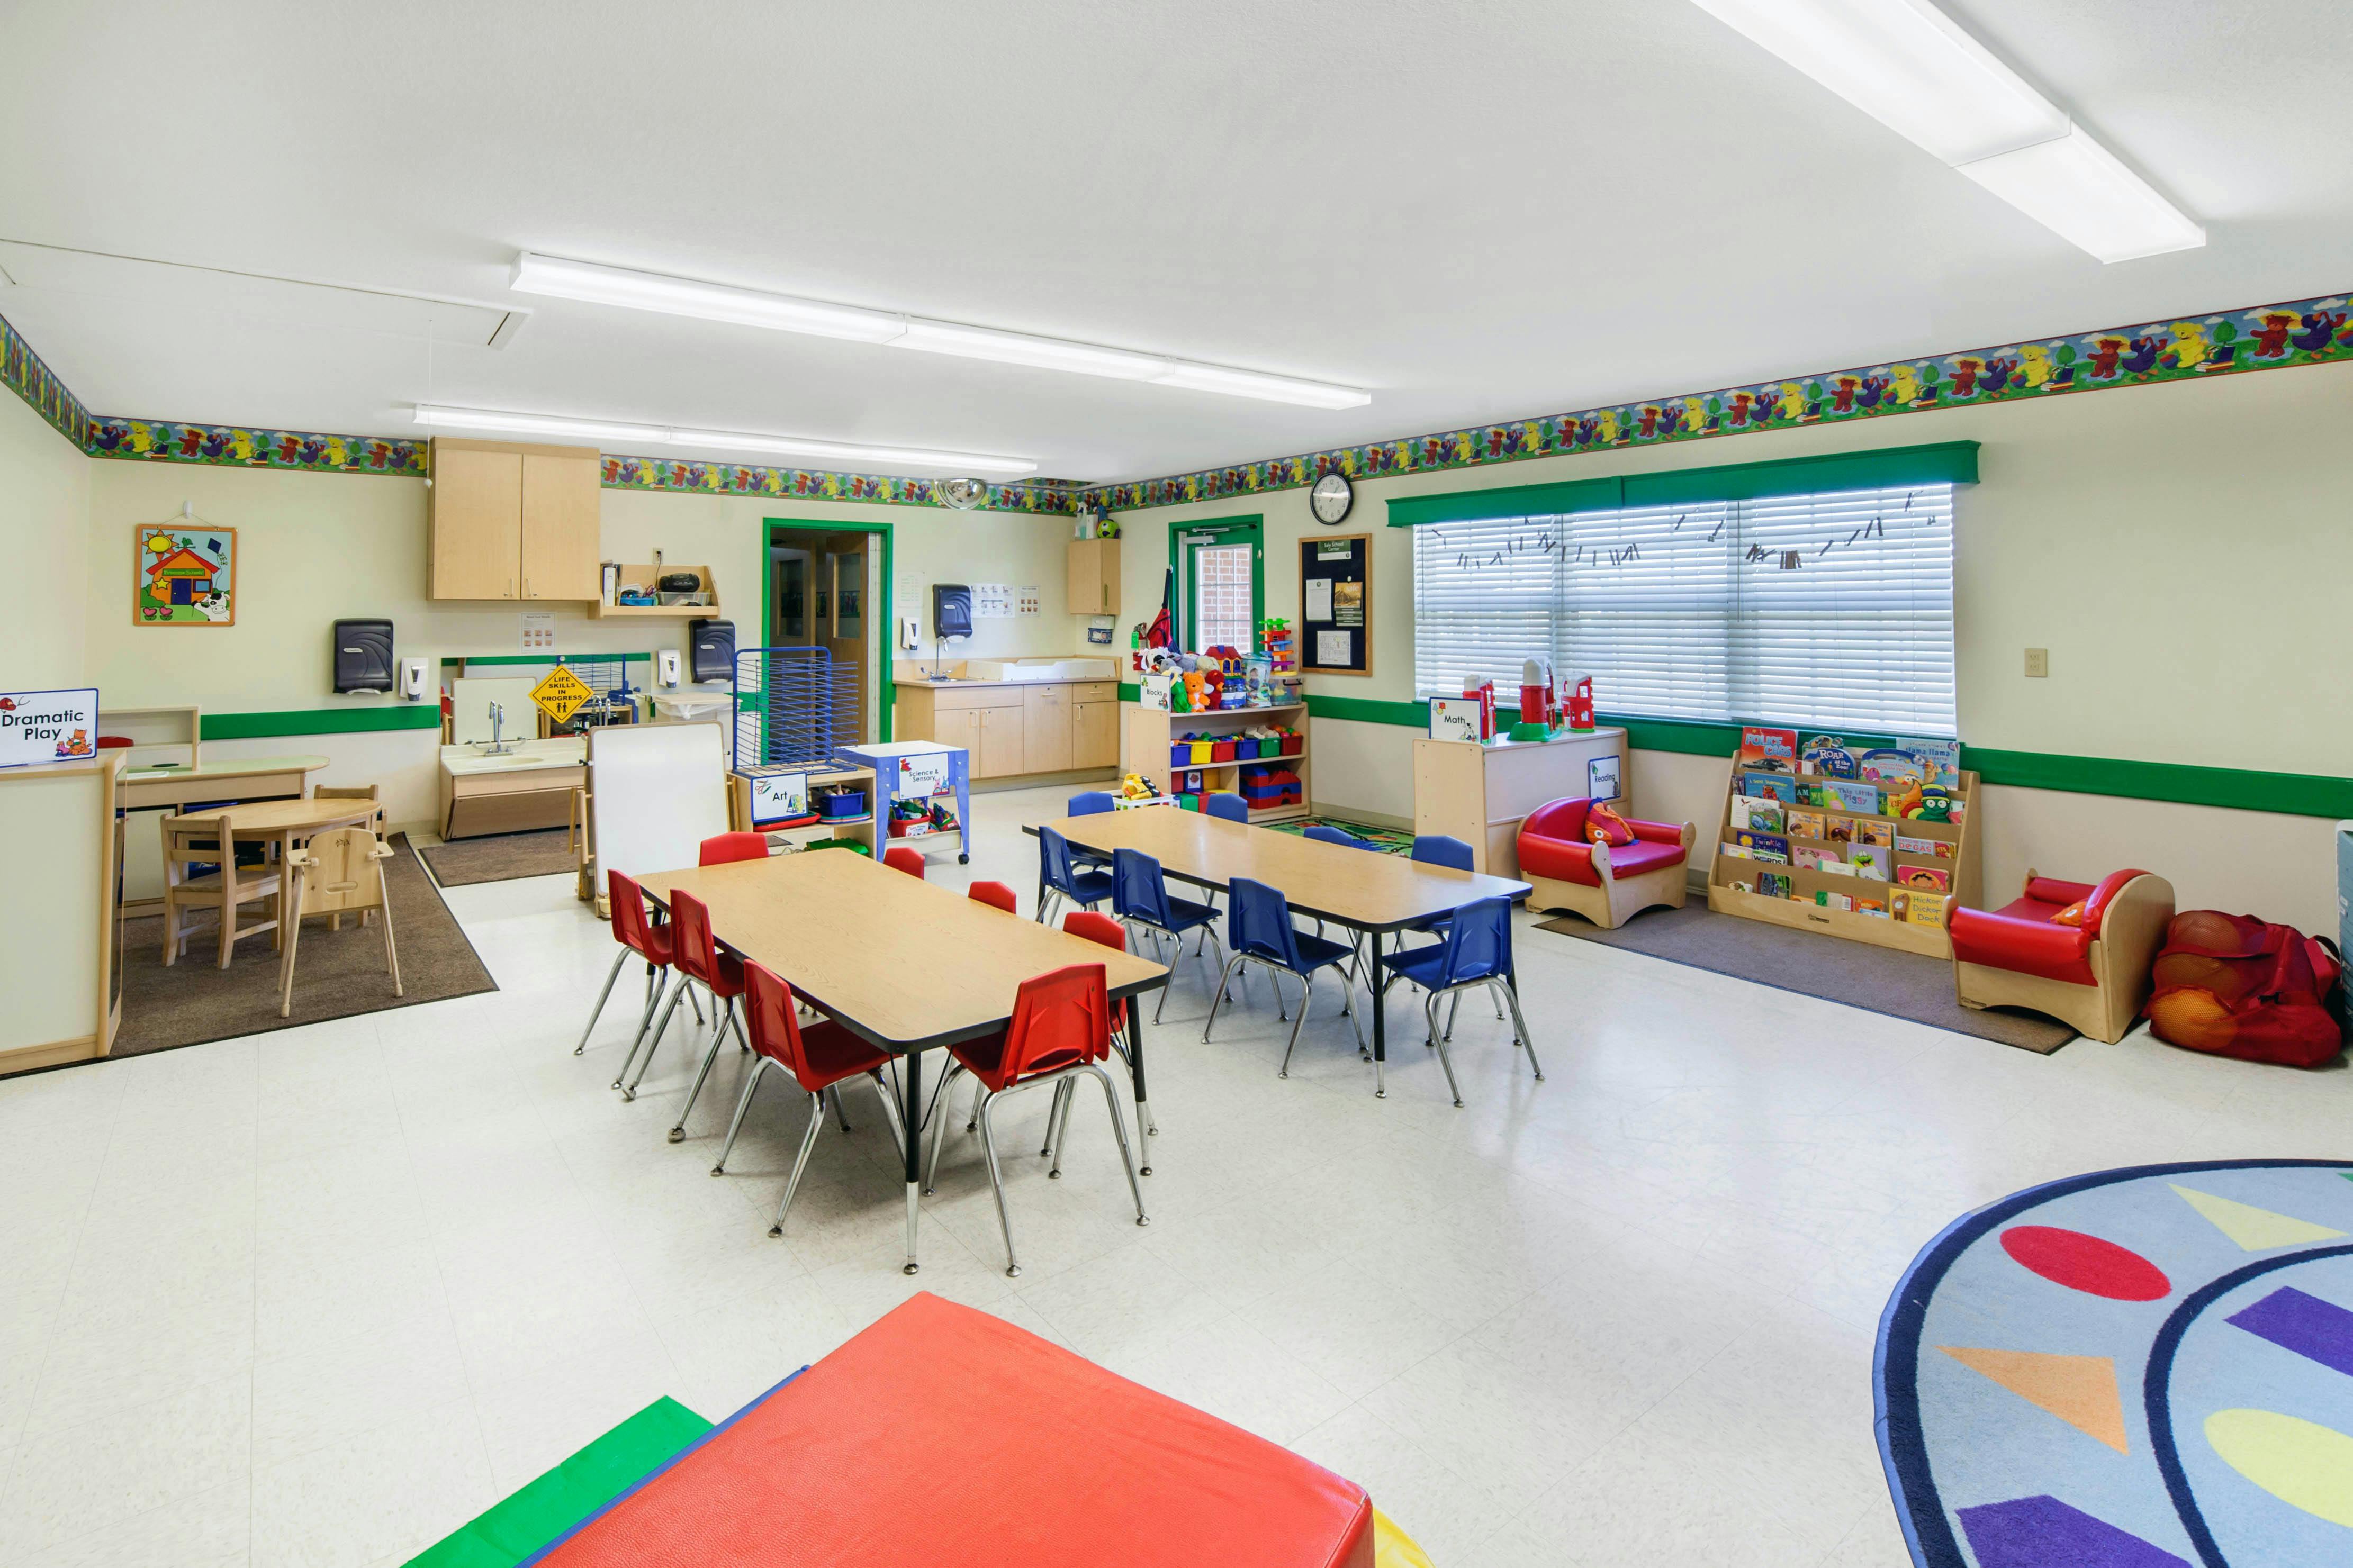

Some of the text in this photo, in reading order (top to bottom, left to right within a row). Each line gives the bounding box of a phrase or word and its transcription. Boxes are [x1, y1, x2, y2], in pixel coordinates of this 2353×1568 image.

[2, 710, 84, 727] Dramatic
[1444, 715, 1465, 724] Math
[25, 728, 61, 741] Play
[1745, 733, 1783, 746] POLICE
[1764, 745, 1792, 758] CARS
[1819, 749, 1844, 759] ROAR
[1594, 774, 1616, 783] Reading
[772, 791, 787, 801] Art
[1844, 794, 1868, 805] Piggy
[1755, 837, 1782, 848] Twinkle
[1913, 896, 1942, 904] Hickor
[1917, 913, 1940, 923] Dock
